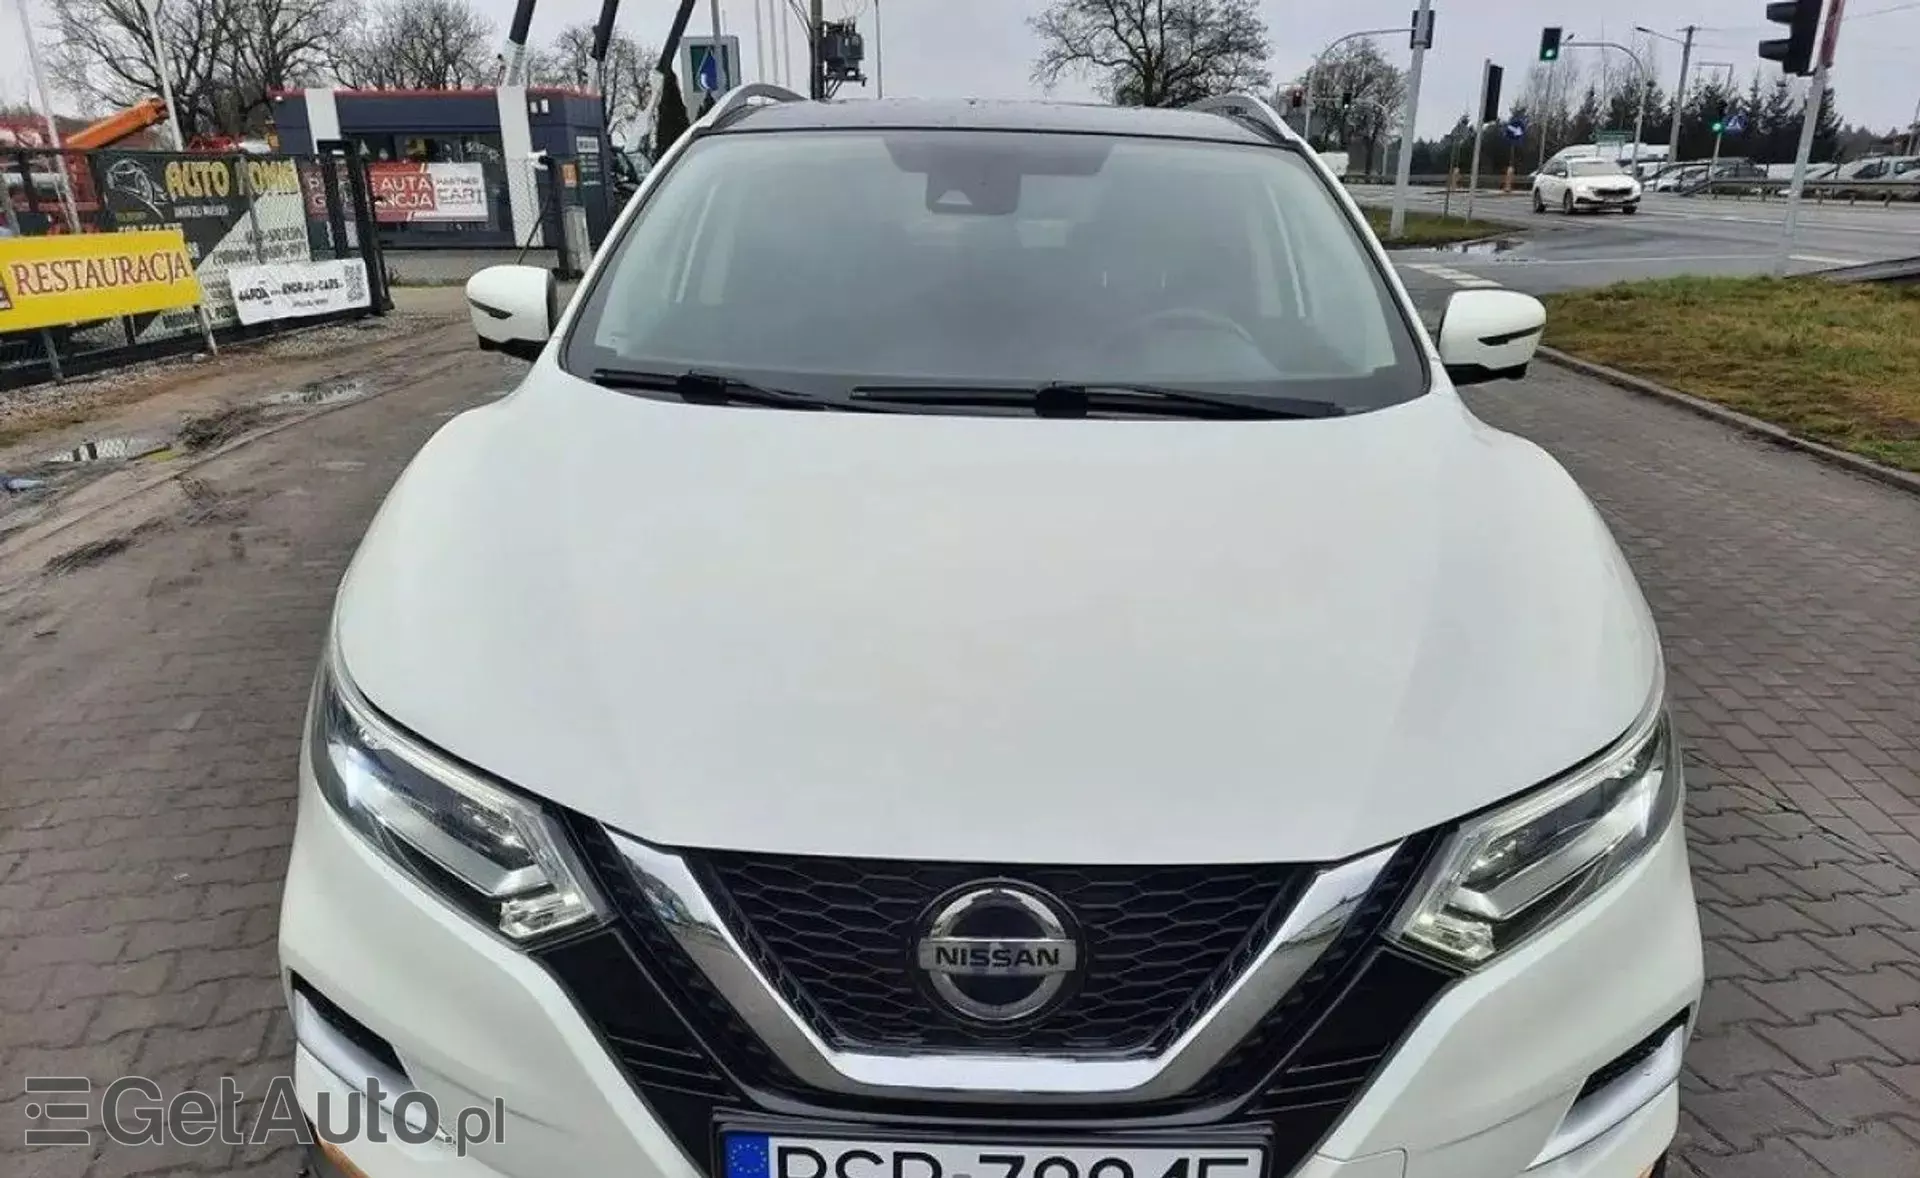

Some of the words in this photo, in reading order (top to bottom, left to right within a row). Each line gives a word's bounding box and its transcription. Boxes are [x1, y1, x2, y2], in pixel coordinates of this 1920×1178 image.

[165, 161, 230, 197] AUTO
[380, 177, 433, 192] AUTA
[10, 251, 191, 296] RESTAURACJA
[935, 947, 1060, 967] NISSAN
